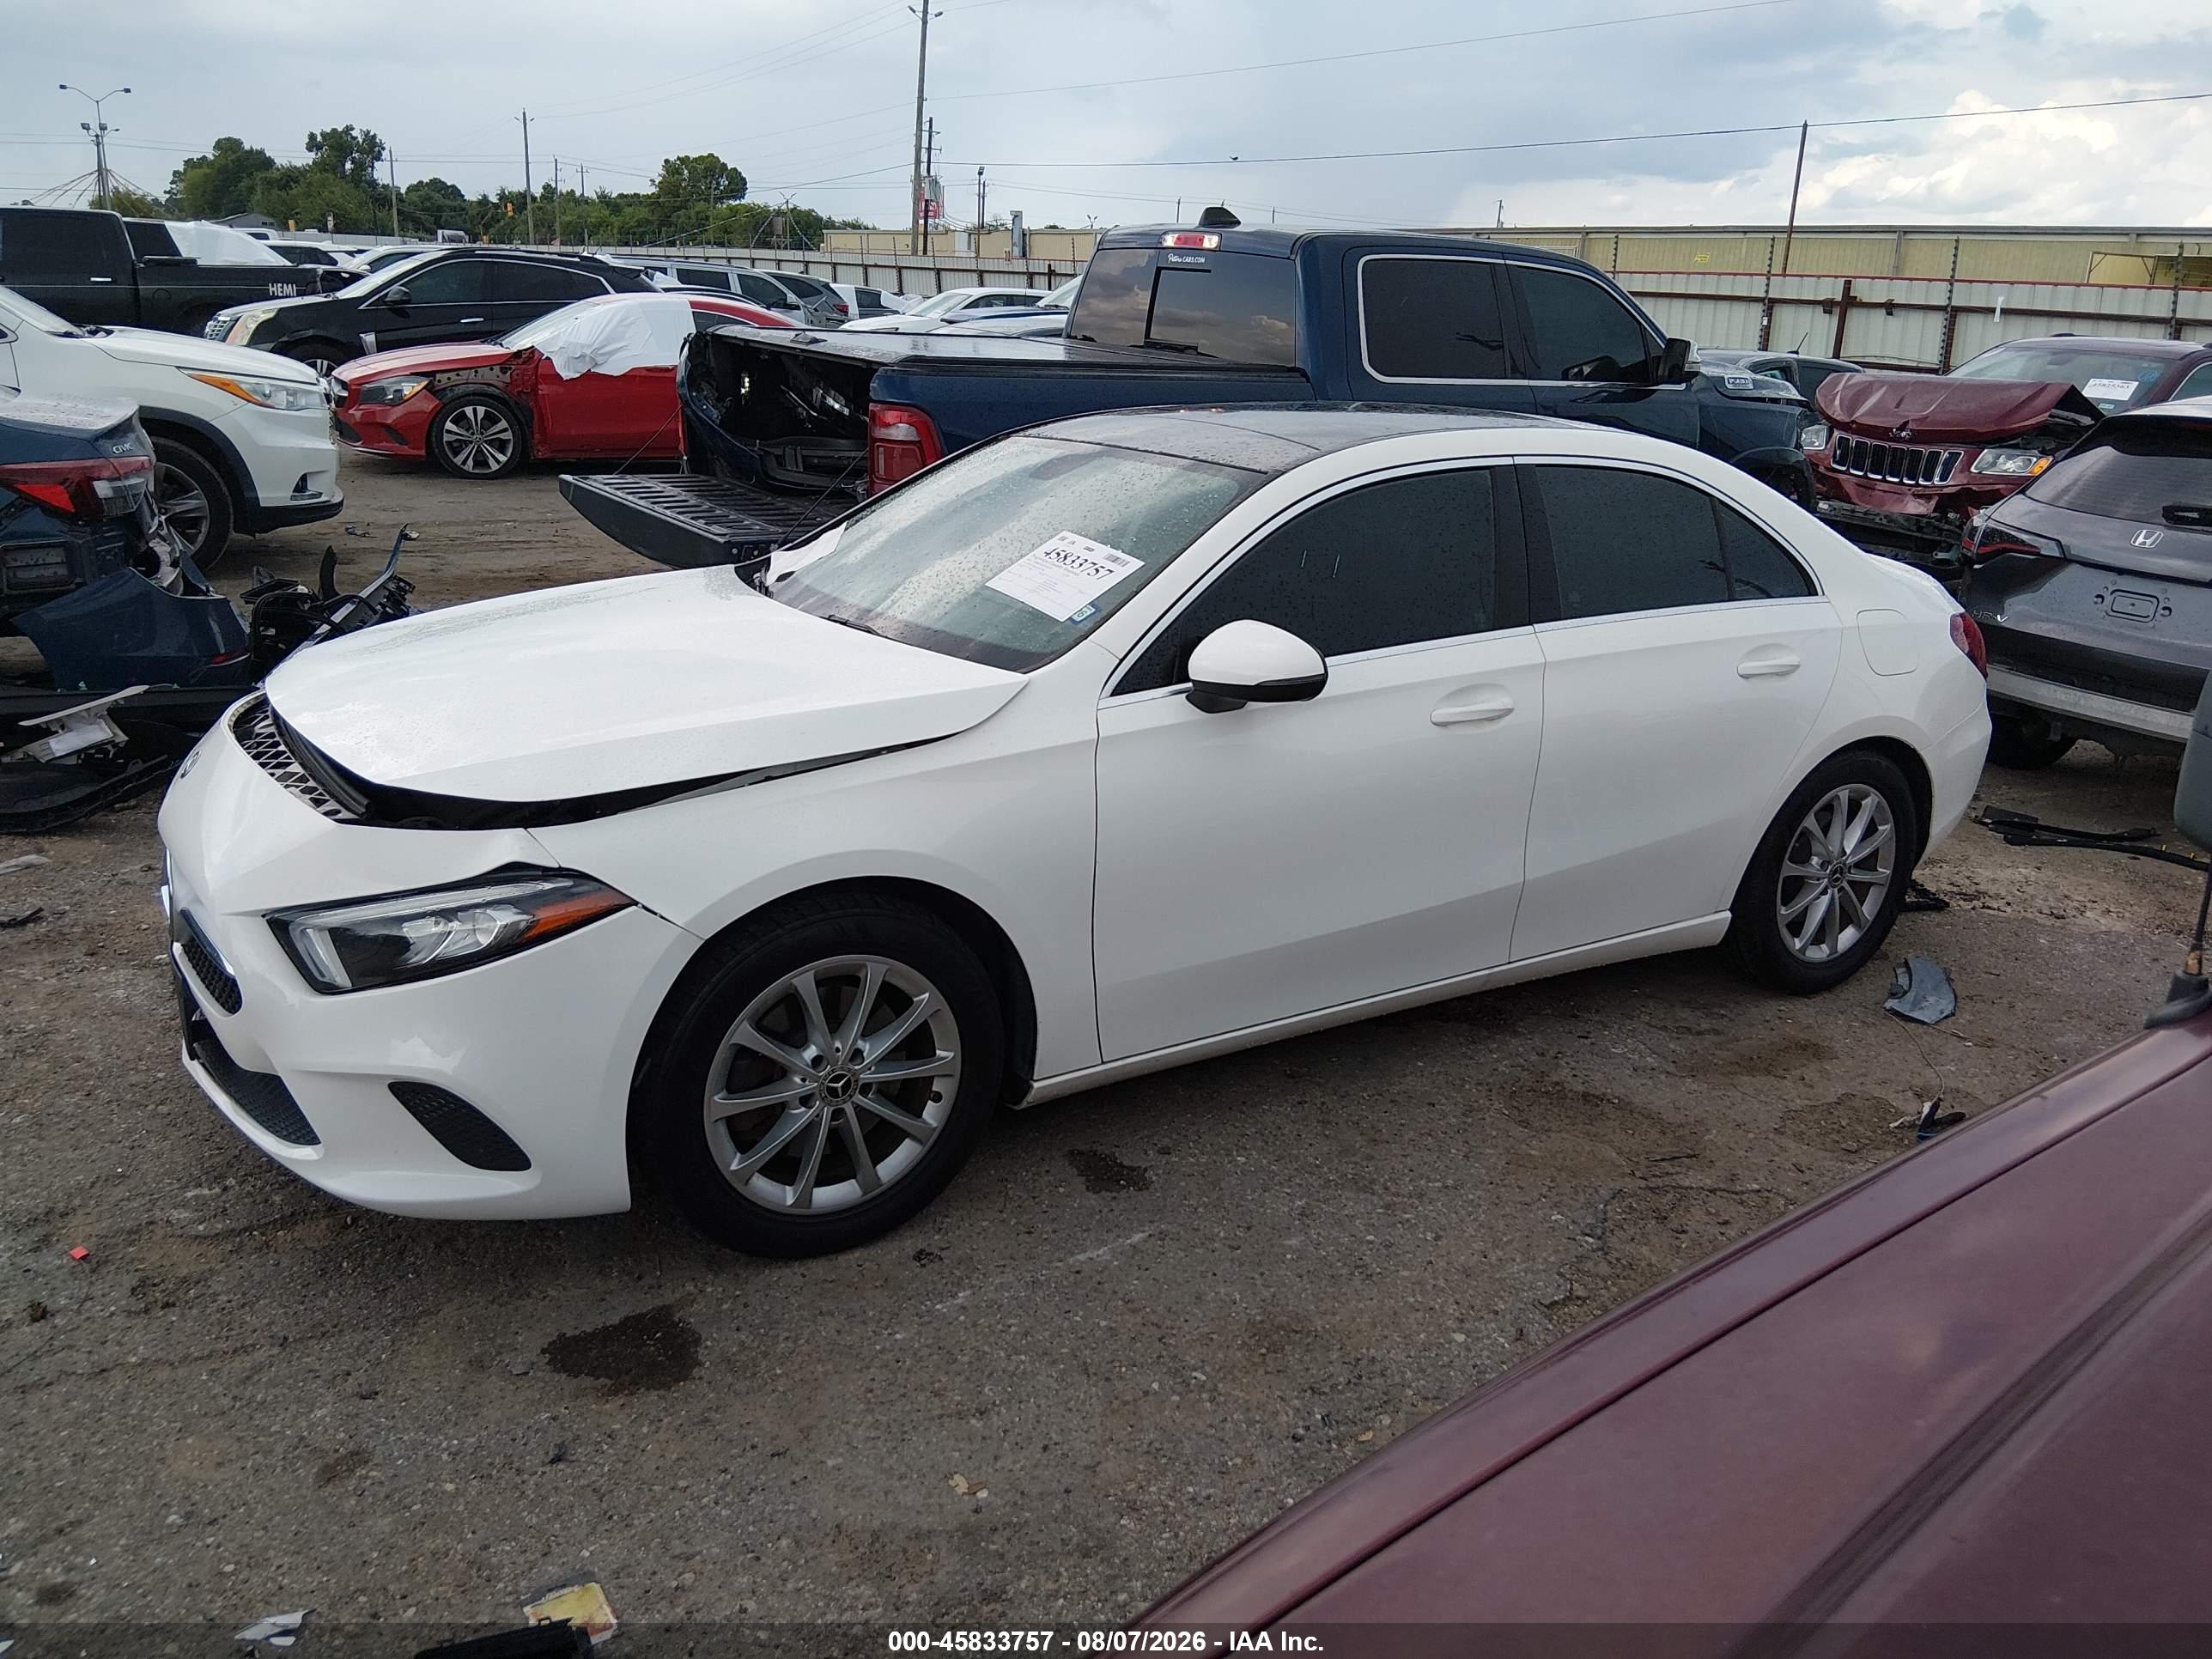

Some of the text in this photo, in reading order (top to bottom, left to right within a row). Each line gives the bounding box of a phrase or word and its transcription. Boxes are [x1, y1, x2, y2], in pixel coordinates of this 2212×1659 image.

[269, 283, 296, 296] HEMI
[112, 443, 133, 453] CIVIC
[1043, 547, 1115, 580] 45833757
